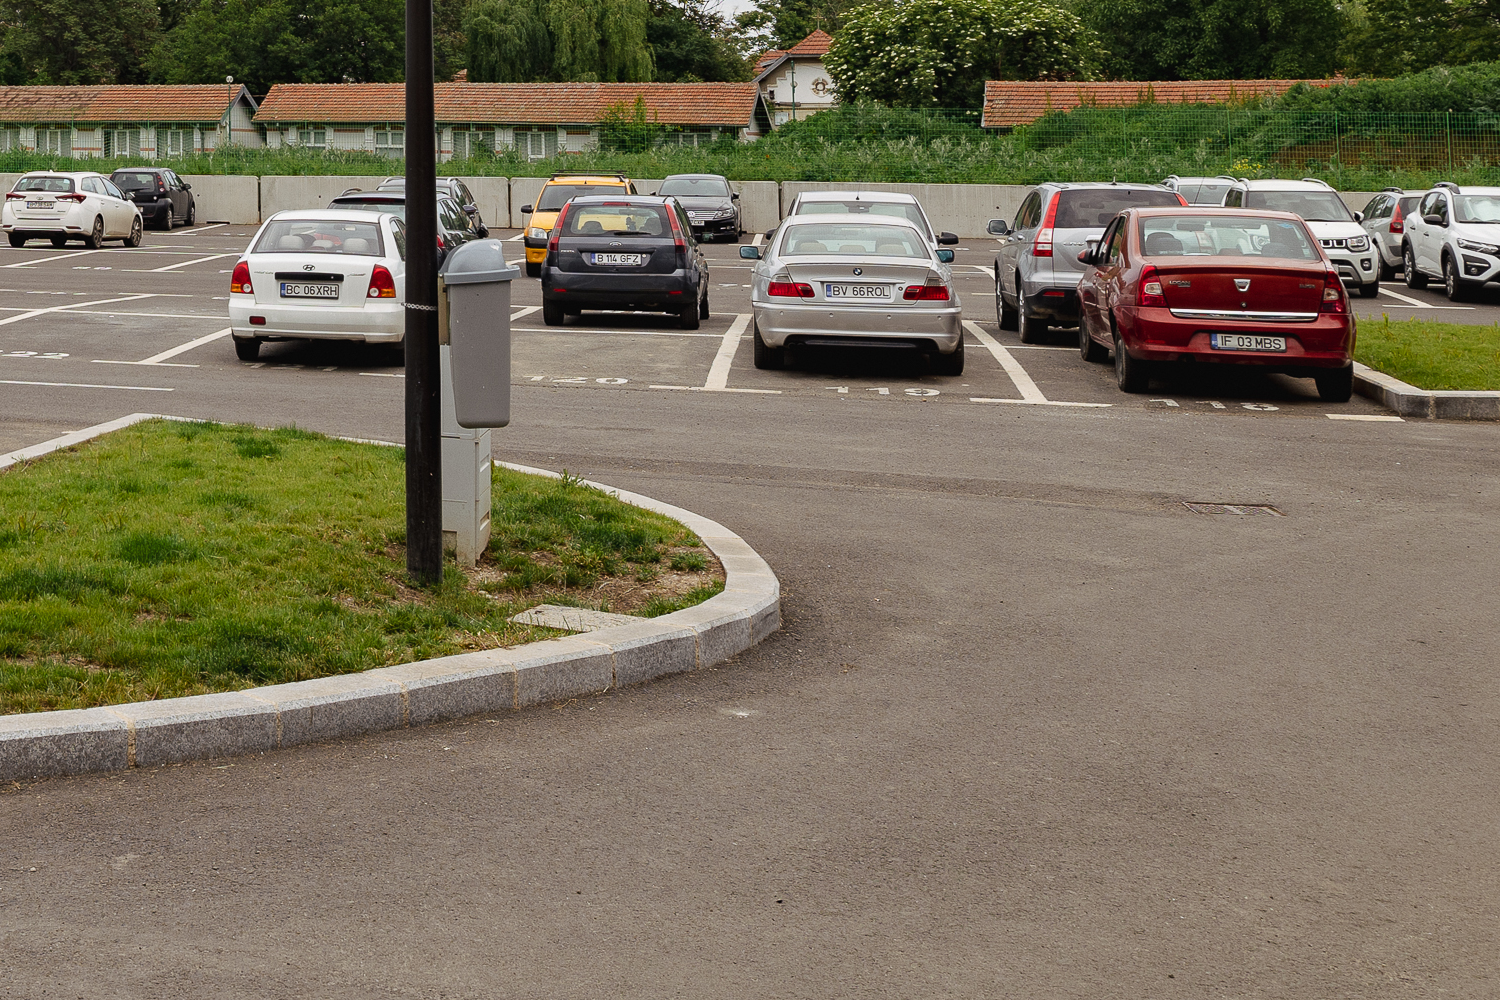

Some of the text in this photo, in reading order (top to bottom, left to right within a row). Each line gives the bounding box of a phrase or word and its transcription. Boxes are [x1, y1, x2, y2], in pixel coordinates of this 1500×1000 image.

[597, 254, 639, 263] B 114 GFZ
[286, 284, 301, 295] BC
[832, 285, 848, 296] BV
[1220, 335, 1233, 347] IF
[522, 374, 629, 385] 120
[824, 386, 941, 397] 119
